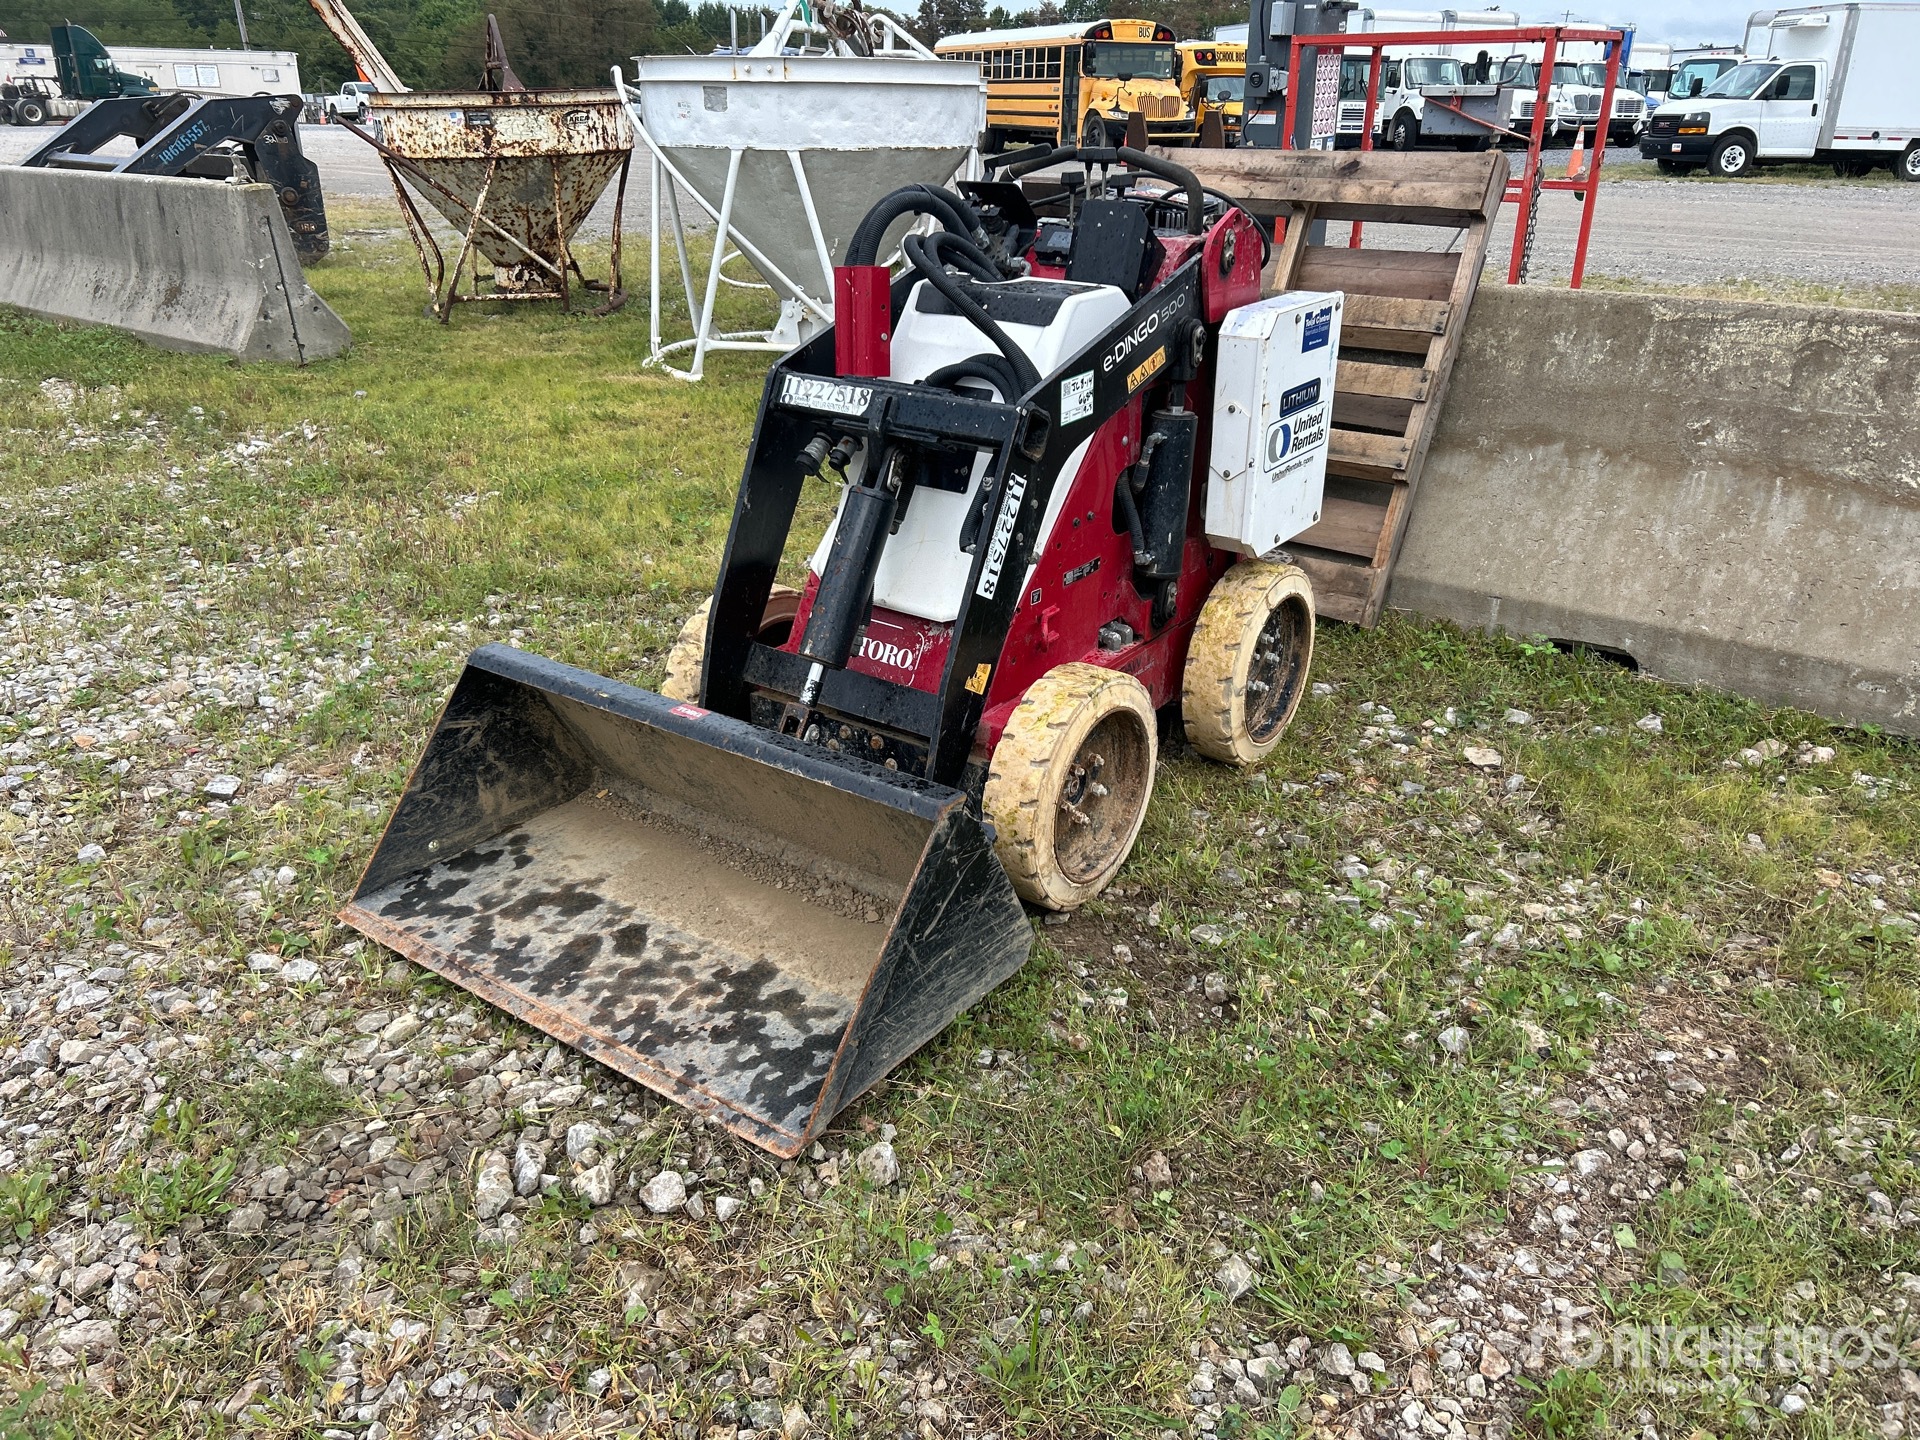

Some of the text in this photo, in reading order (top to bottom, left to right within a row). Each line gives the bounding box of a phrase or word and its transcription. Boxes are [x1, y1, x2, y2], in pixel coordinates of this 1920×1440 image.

[1138, 27, 1151, 38] BUS
[1216, 51, 1245, 62] SCHOOL BUS
[1161, 293, 1186, 323] 500
[785, 377, 870, 407] 11227518
[1283, 385, 1318, 410] LITHIUM
[1293, 408, 1325, 435] United
[1290, 426, 1324, 454] Rentals
[983, 479, 1025, 595] 11227518
[858, 636, 913, 670] TORO
